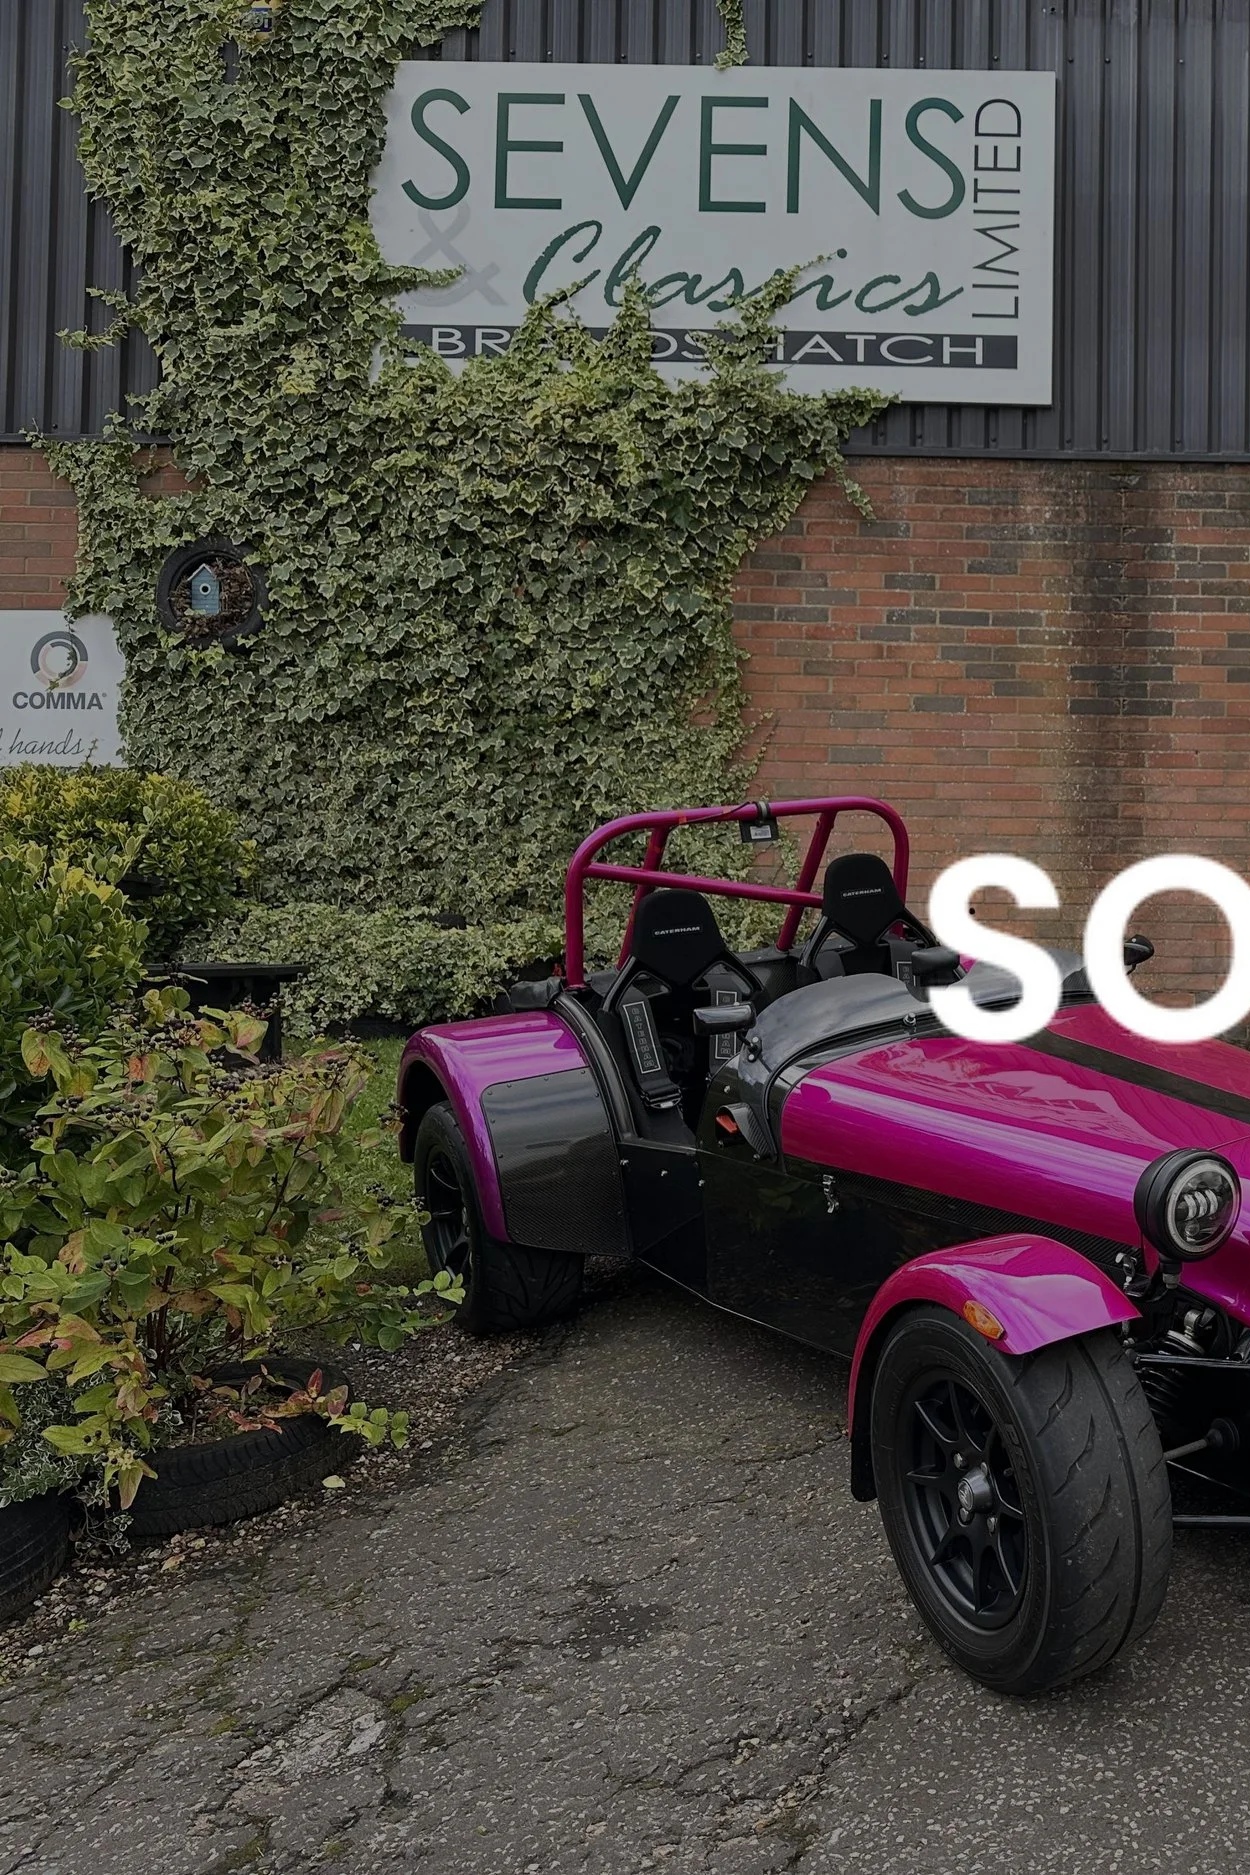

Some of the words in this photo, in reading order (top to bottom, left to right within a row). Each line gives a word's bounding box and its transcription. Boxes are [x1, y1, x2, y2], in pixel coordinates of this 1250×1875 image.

[401, 88, 966, 219] SEVENS
[971, 98, 1022, 320] LIMITED
[432, 327, 716, 361] BRDS
[12, 691, 104, 710] COMMA
[9, 728, 85, 756] hands
[653, 925, 701, 936] CATERHAM
